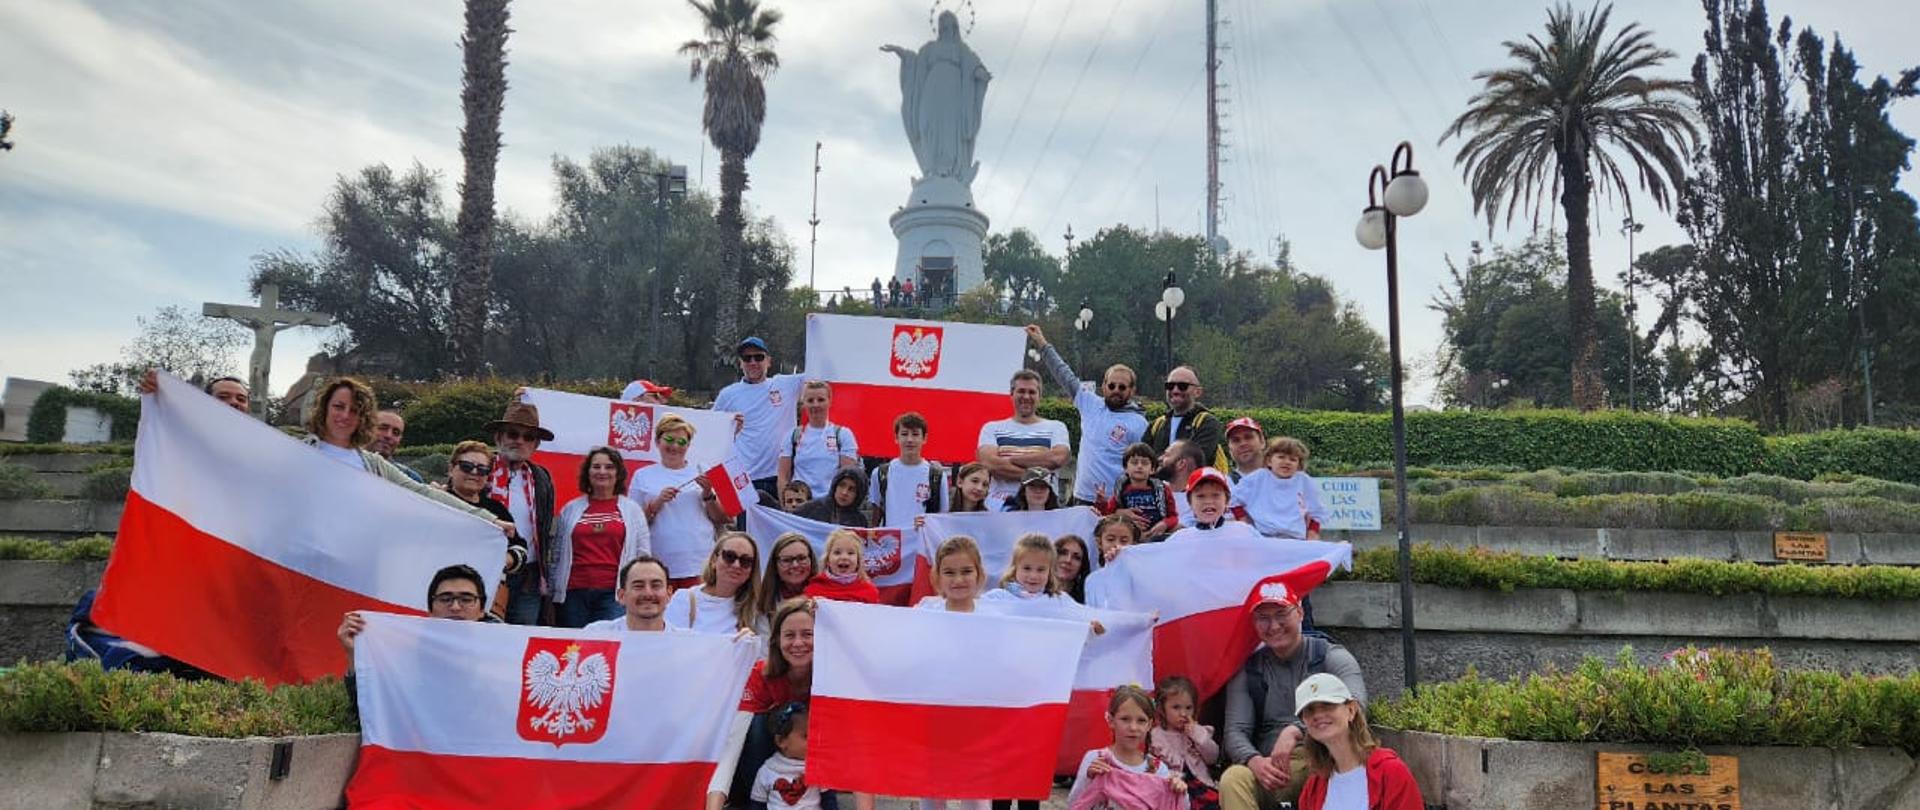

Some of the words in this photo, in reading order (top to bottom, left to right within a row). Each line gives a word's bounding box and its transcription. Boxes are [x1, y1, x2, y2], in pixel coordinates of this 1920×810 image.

[1322, 481, 1359, 492] CUIDE
[1332, 494, 1357, 505] LAS
[1331, 509, 1374, 520] ANTAS
[1643, 782, 1695, 794] LAS
